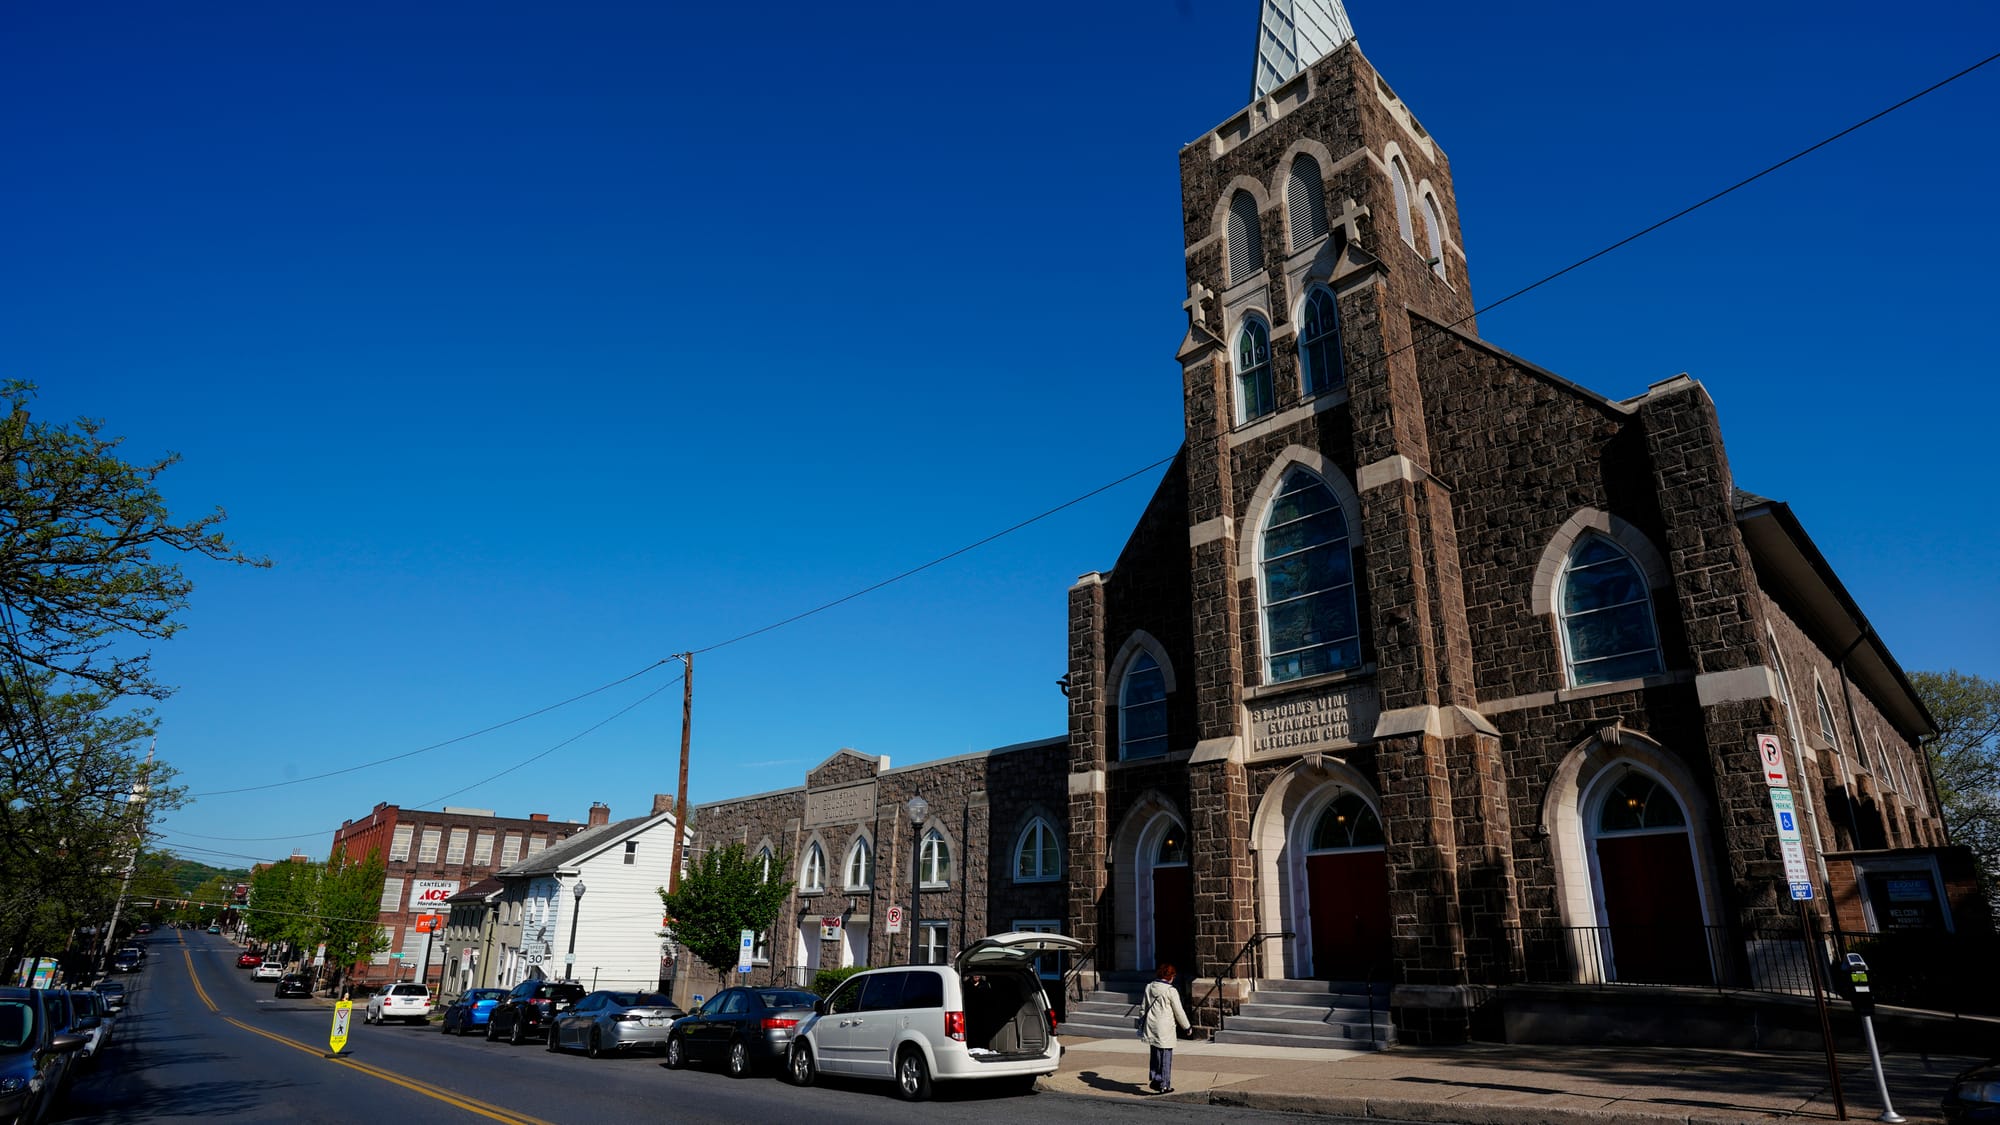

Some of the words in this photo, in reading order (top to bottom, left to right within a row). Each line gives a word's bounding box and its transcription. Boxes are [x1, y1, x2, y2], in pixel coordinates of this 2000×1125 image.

[1254, 727, 1321, 752] LUTHERAN
[823, 799, 858, 810] EDUCATION
[823, 809, 855, 819] BUILDING
[419, 888, 451, 901] ACE
[528, 954, 543, 964] 30
